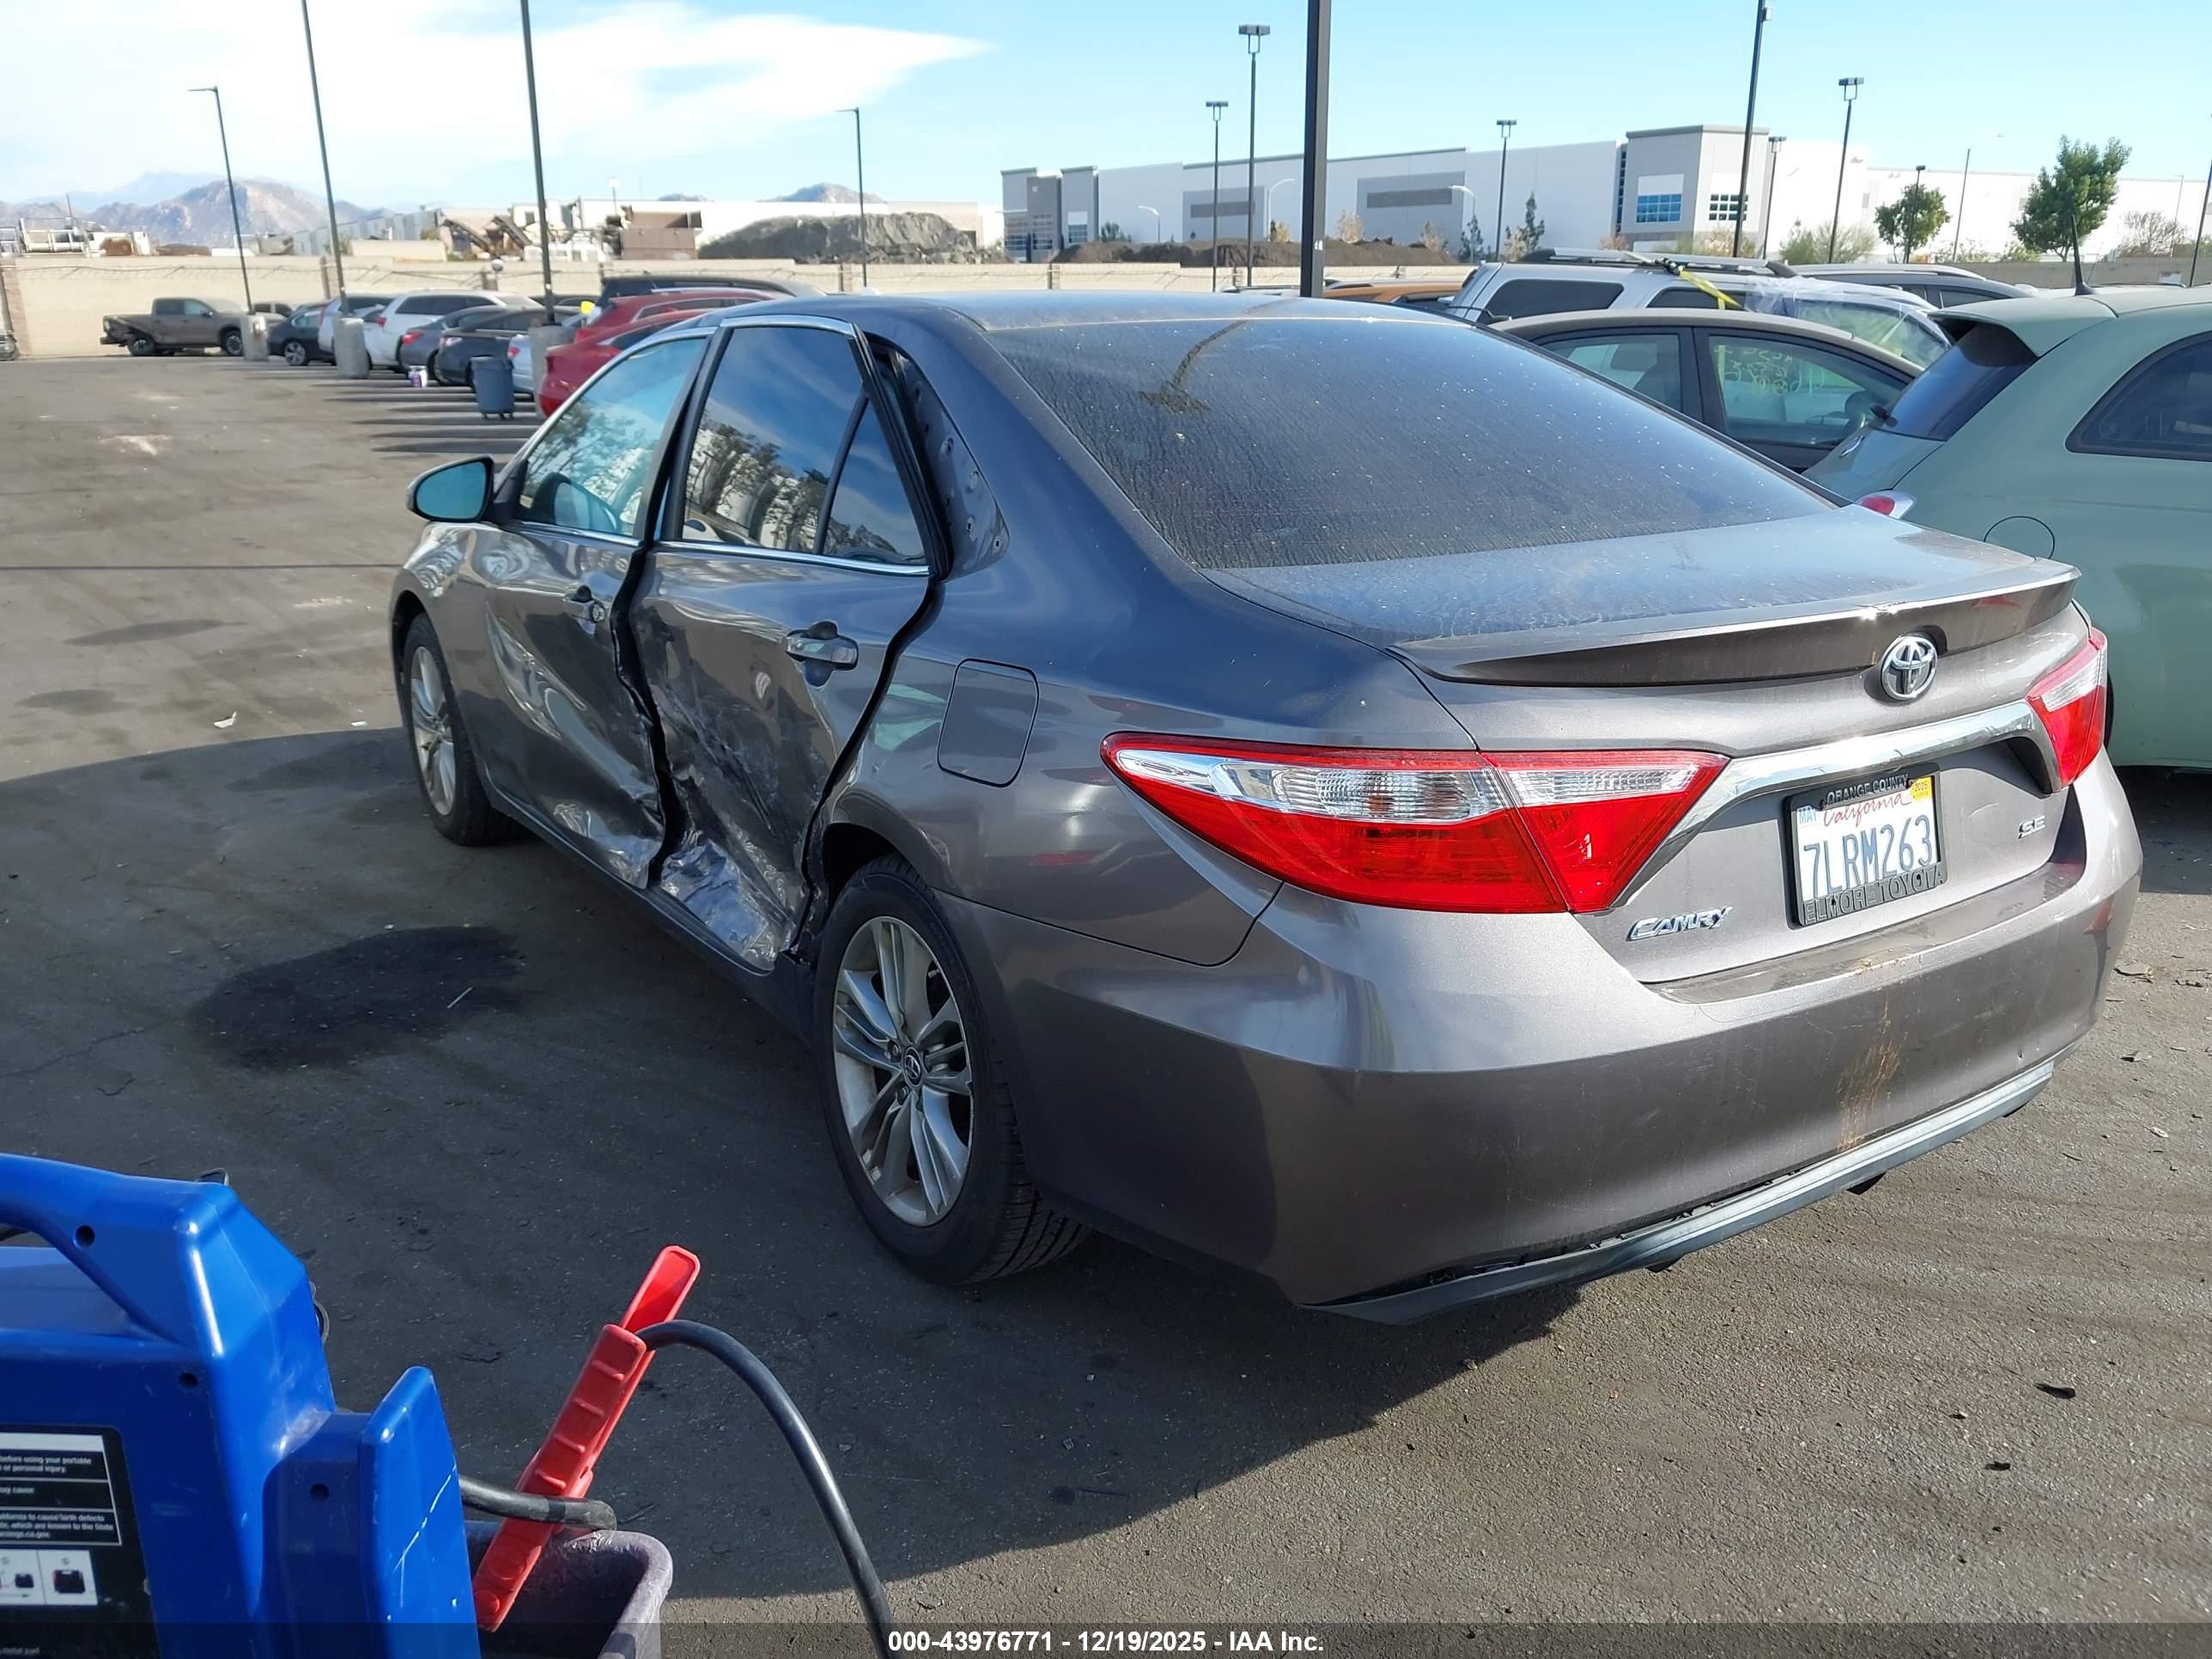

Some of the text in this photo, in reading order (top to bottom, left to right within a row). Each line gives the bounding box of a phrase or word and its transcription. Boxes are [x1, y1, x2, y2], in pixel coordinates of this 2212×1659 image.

[1826, 774, 1908, 805] ORANGE COUNTY
[1823, 793, 1911, 828] California
[1803, 815, 1933, 898] 7LRM263
[1804, 866, 1945, 926] ELMORE TOYOTA
[1626, 906, 1734, 941] CAMRY
